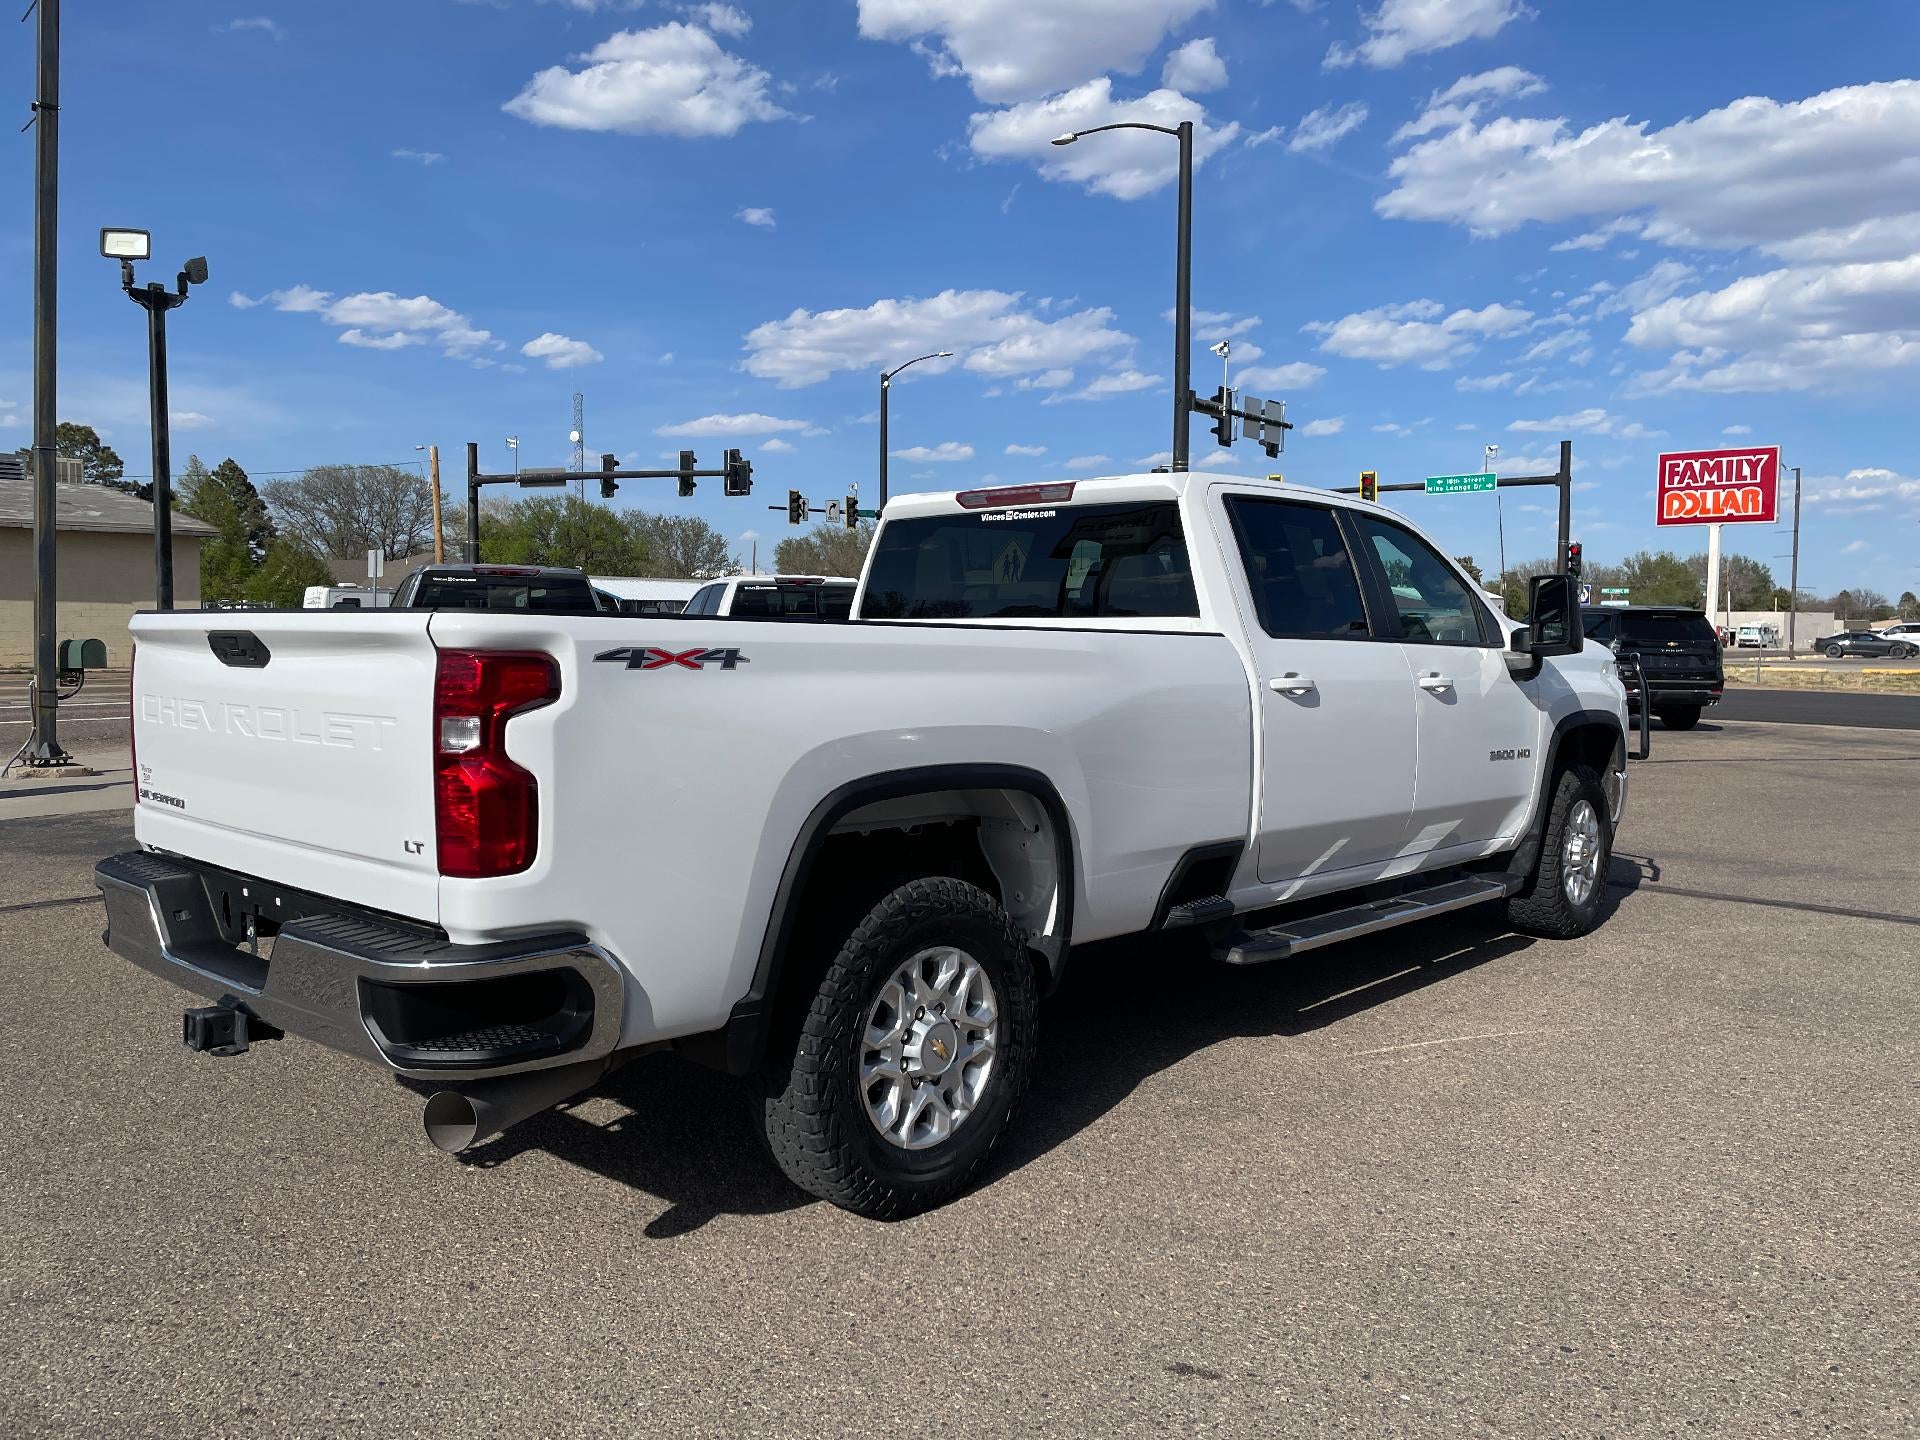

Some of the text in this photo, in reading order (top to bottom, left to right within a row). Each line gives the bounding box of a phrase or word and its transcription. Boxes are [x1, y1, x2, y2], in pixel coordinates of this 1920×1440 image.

[1463, 476, 1486, 484] Street
[1665, 454, 1770, 488] FAMILY
[1664, 487, 1763, 519] DOLLAR
[142, 693, 398, 752] CHEVROLET
[1517, 748, 1531, 760] HD
[404, 840, 425, 856] LT
